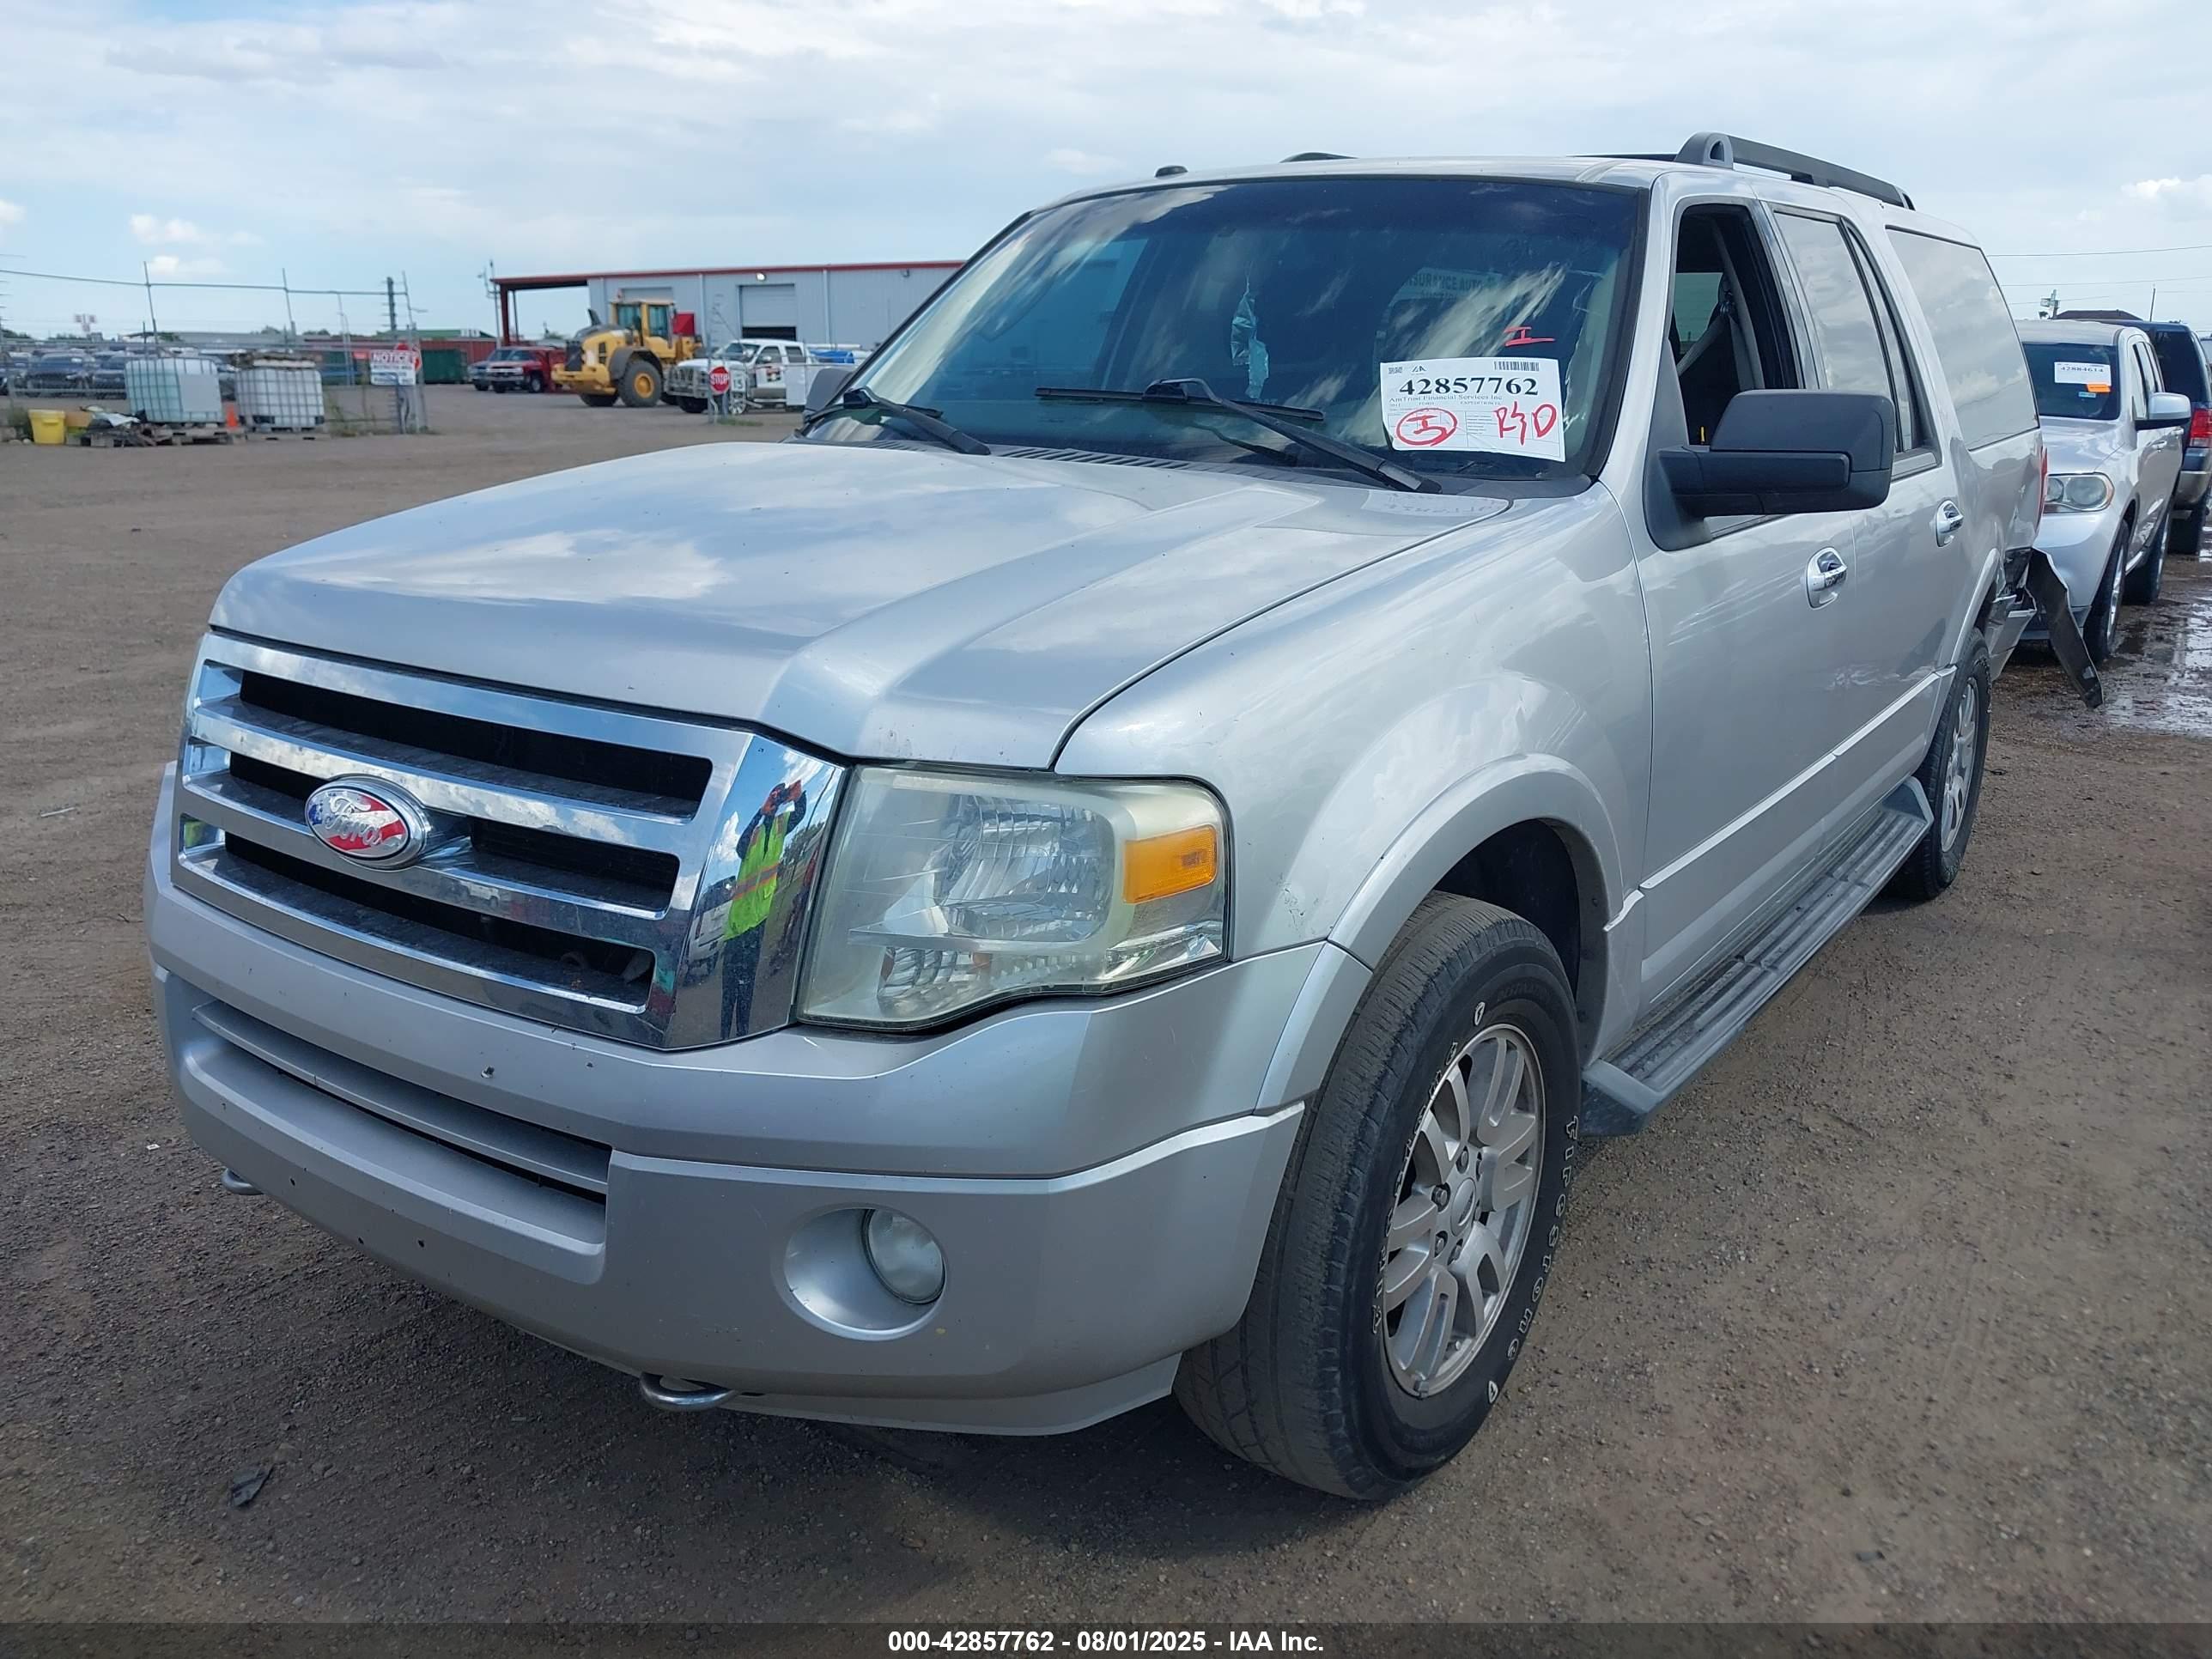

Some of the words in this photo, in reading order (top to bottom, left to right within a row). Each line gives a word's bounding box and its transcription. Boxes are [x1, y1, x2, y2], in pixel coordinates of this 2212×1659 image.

[710, 373, 730, 386] STOP
[1399, 376, 1539, 395] 42857762
[1506, 1115, 1579, 1360] Firestone
